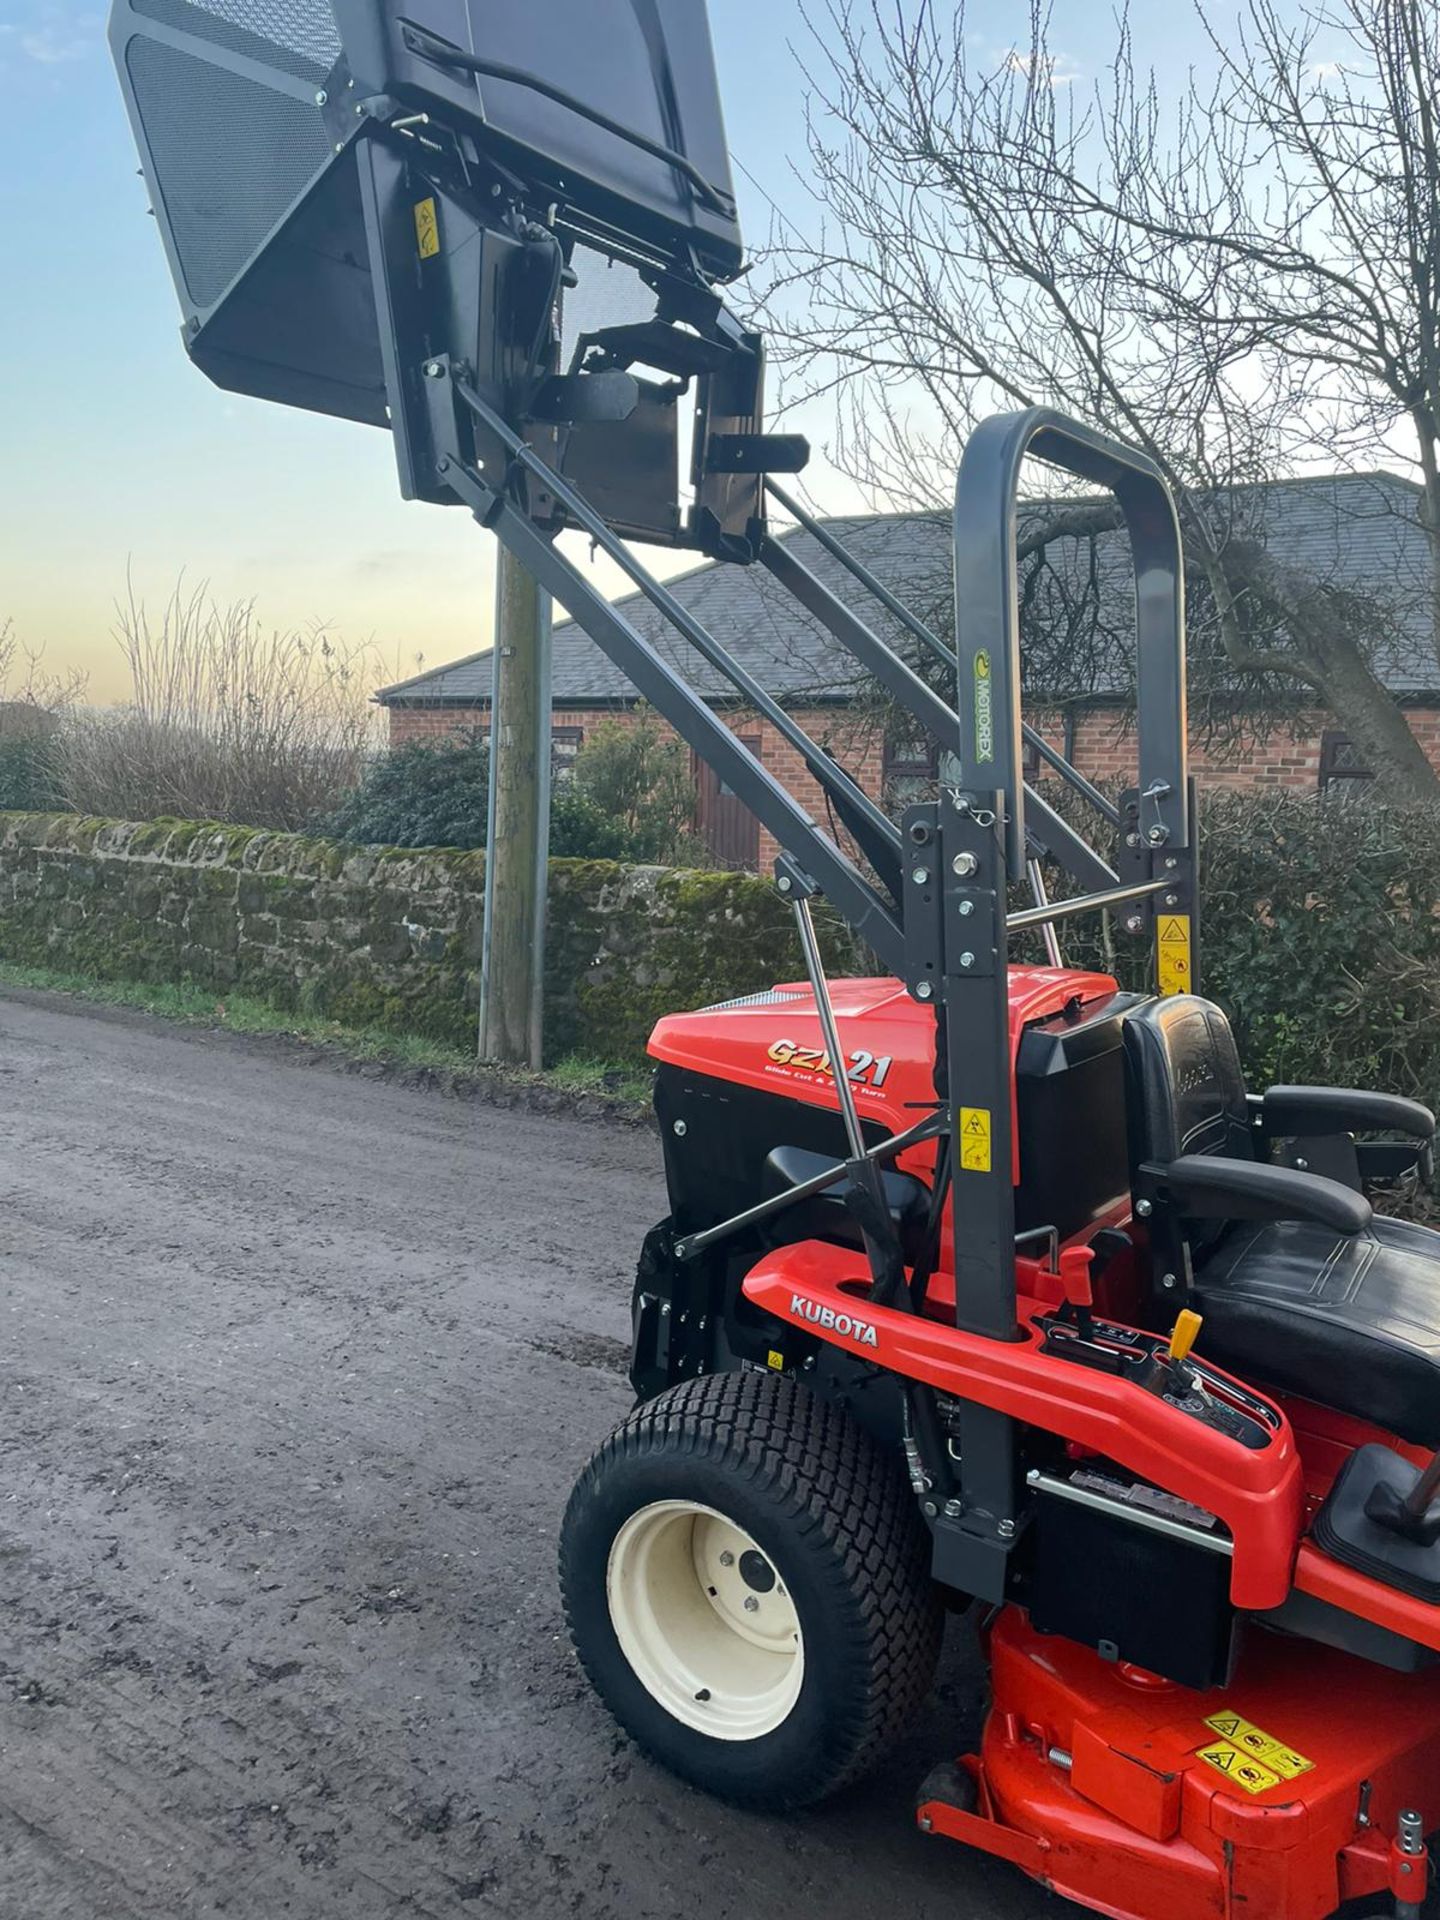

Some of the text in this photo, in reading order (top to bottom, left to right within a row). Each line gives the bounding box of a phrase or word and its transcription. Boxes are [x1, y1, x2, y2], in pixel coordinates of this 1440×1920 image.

[794, 1071, 812, 1081] Cut
[861, 1087, 886, 1099] Turn
[790, 1294, 878, 1347] KUBOTA
